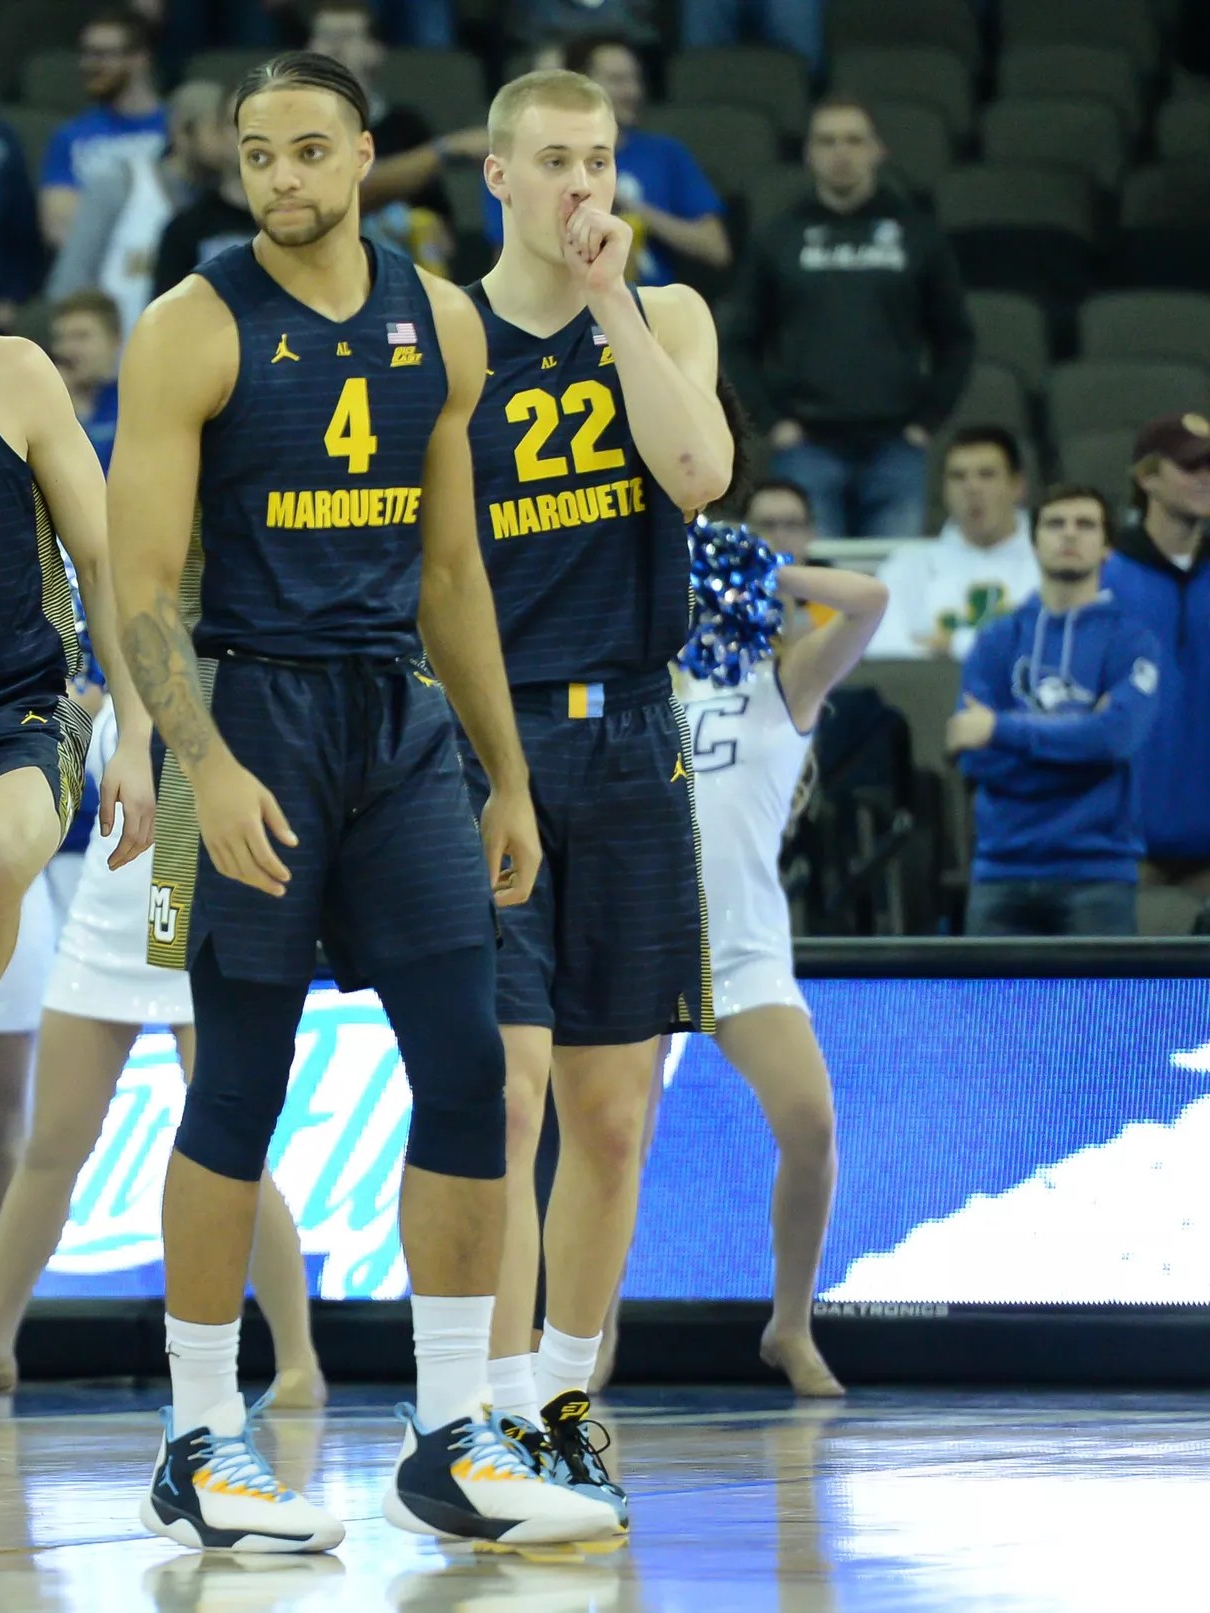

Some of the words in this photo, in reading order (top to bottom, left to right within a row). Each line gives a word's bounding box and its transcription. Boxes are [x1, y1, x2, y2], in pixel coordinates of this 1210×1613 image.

[336, 341, 352, 356] AL
[541, 355, 558, 370] AL
[323, 377, 378, 474] 4
[505, 379, 625, 483] 22
[266, 487, 422, 529] MARQUETTE
[682, 693, 750, 773] C
[150, 885, 178, 943] MU
[813, 1301, 949, 1318] DAKTRONICS
